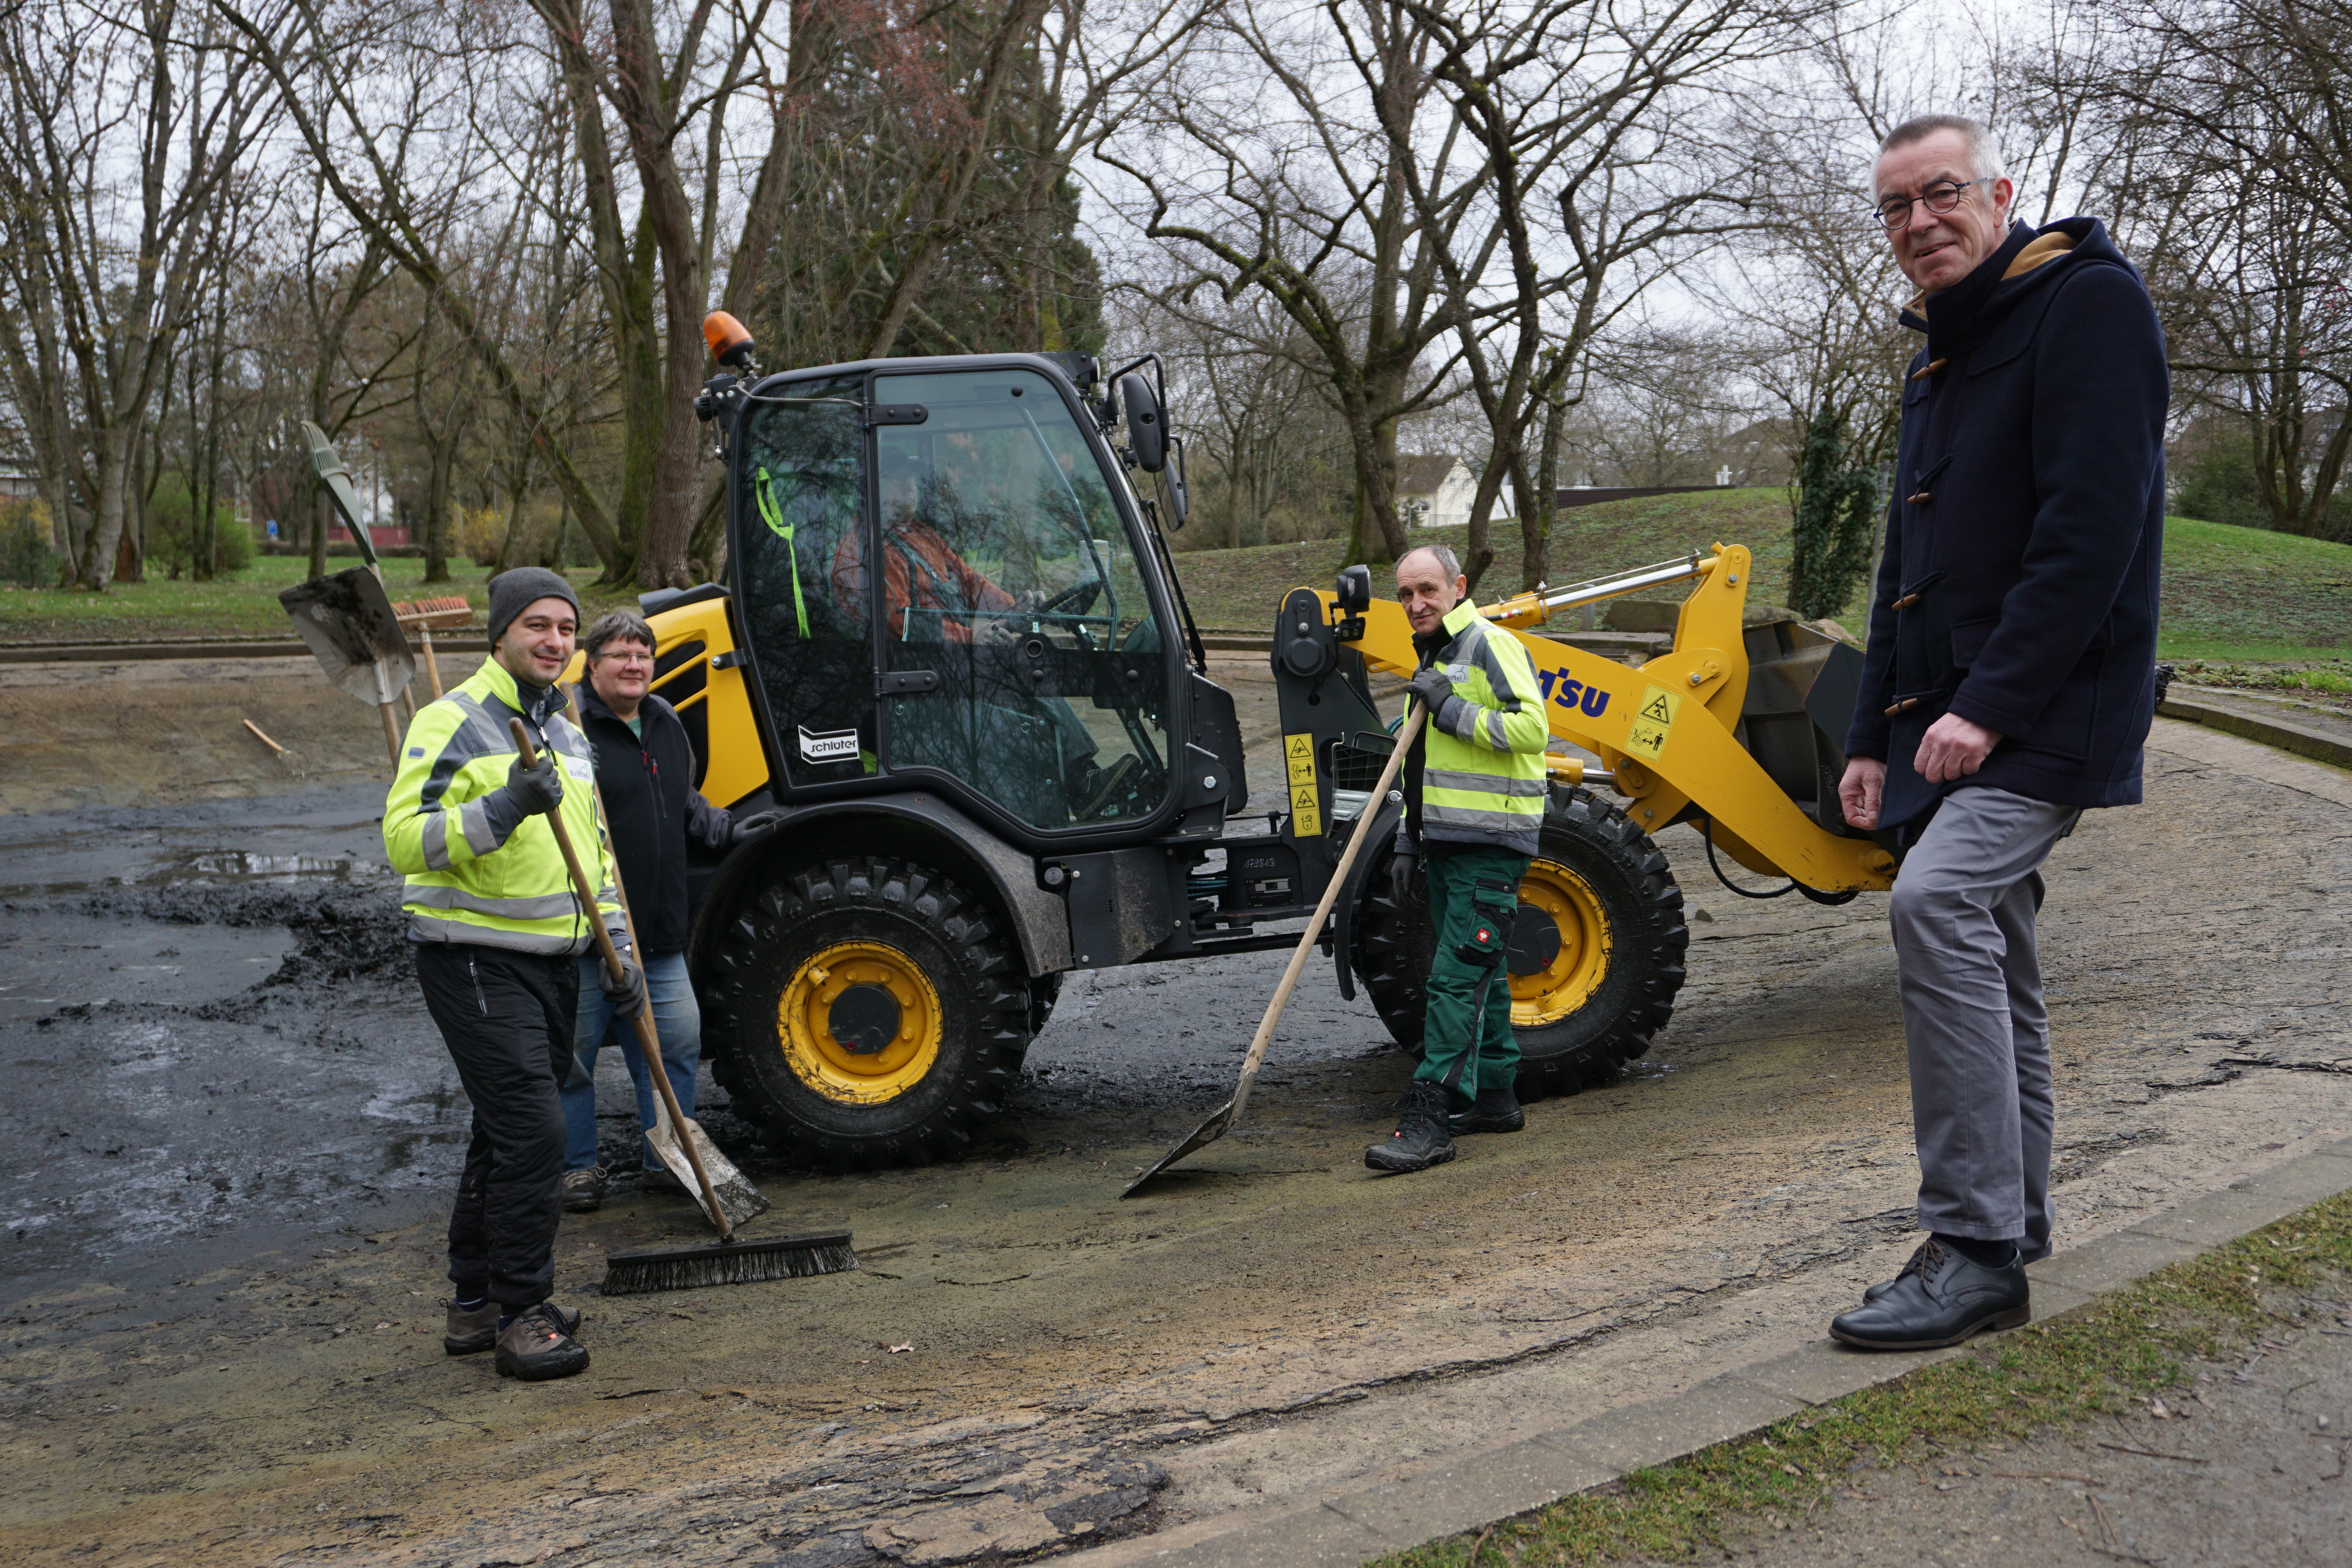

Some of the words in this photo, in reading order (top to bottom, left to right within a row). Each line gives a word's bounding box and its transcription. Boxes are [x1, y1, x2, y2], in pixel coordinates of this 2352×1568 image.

[811, 740, 856, 753] schlüter
[570, 769, 588, 779] Kriftel
[1243, 858, 1275, 868] 179813
